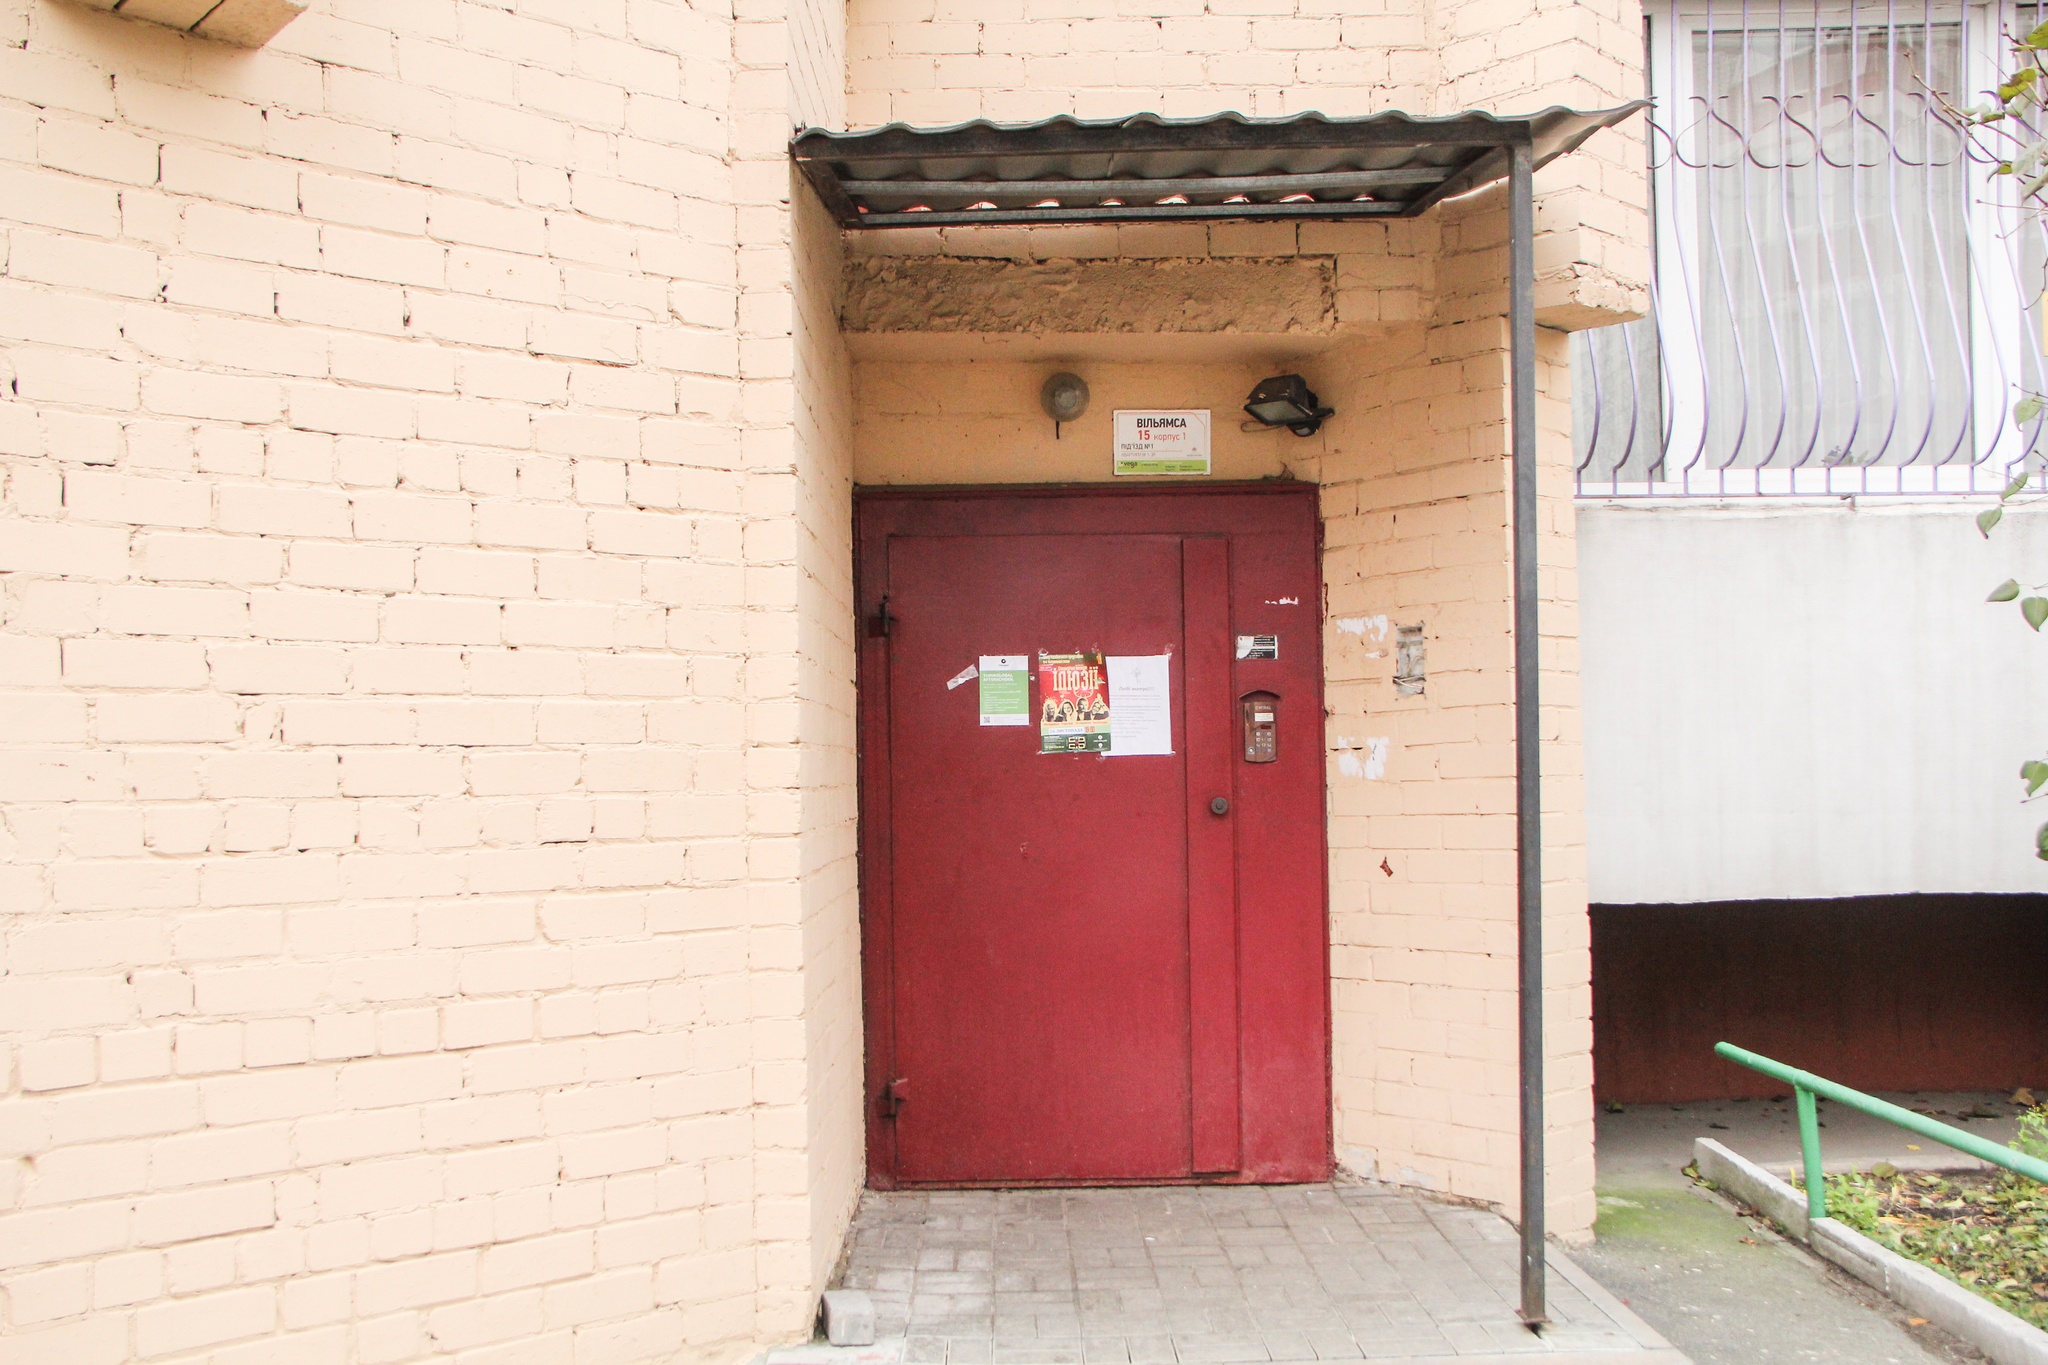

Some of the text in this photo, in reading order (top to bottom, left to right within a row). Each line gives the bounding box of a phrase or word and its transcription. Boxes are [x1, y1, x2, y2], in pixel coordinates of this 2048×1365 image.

[1136, 418, 1187, 428] ВІЛЬЯМСА
[1138, 430, 1186, 442] 15 корпус 1
